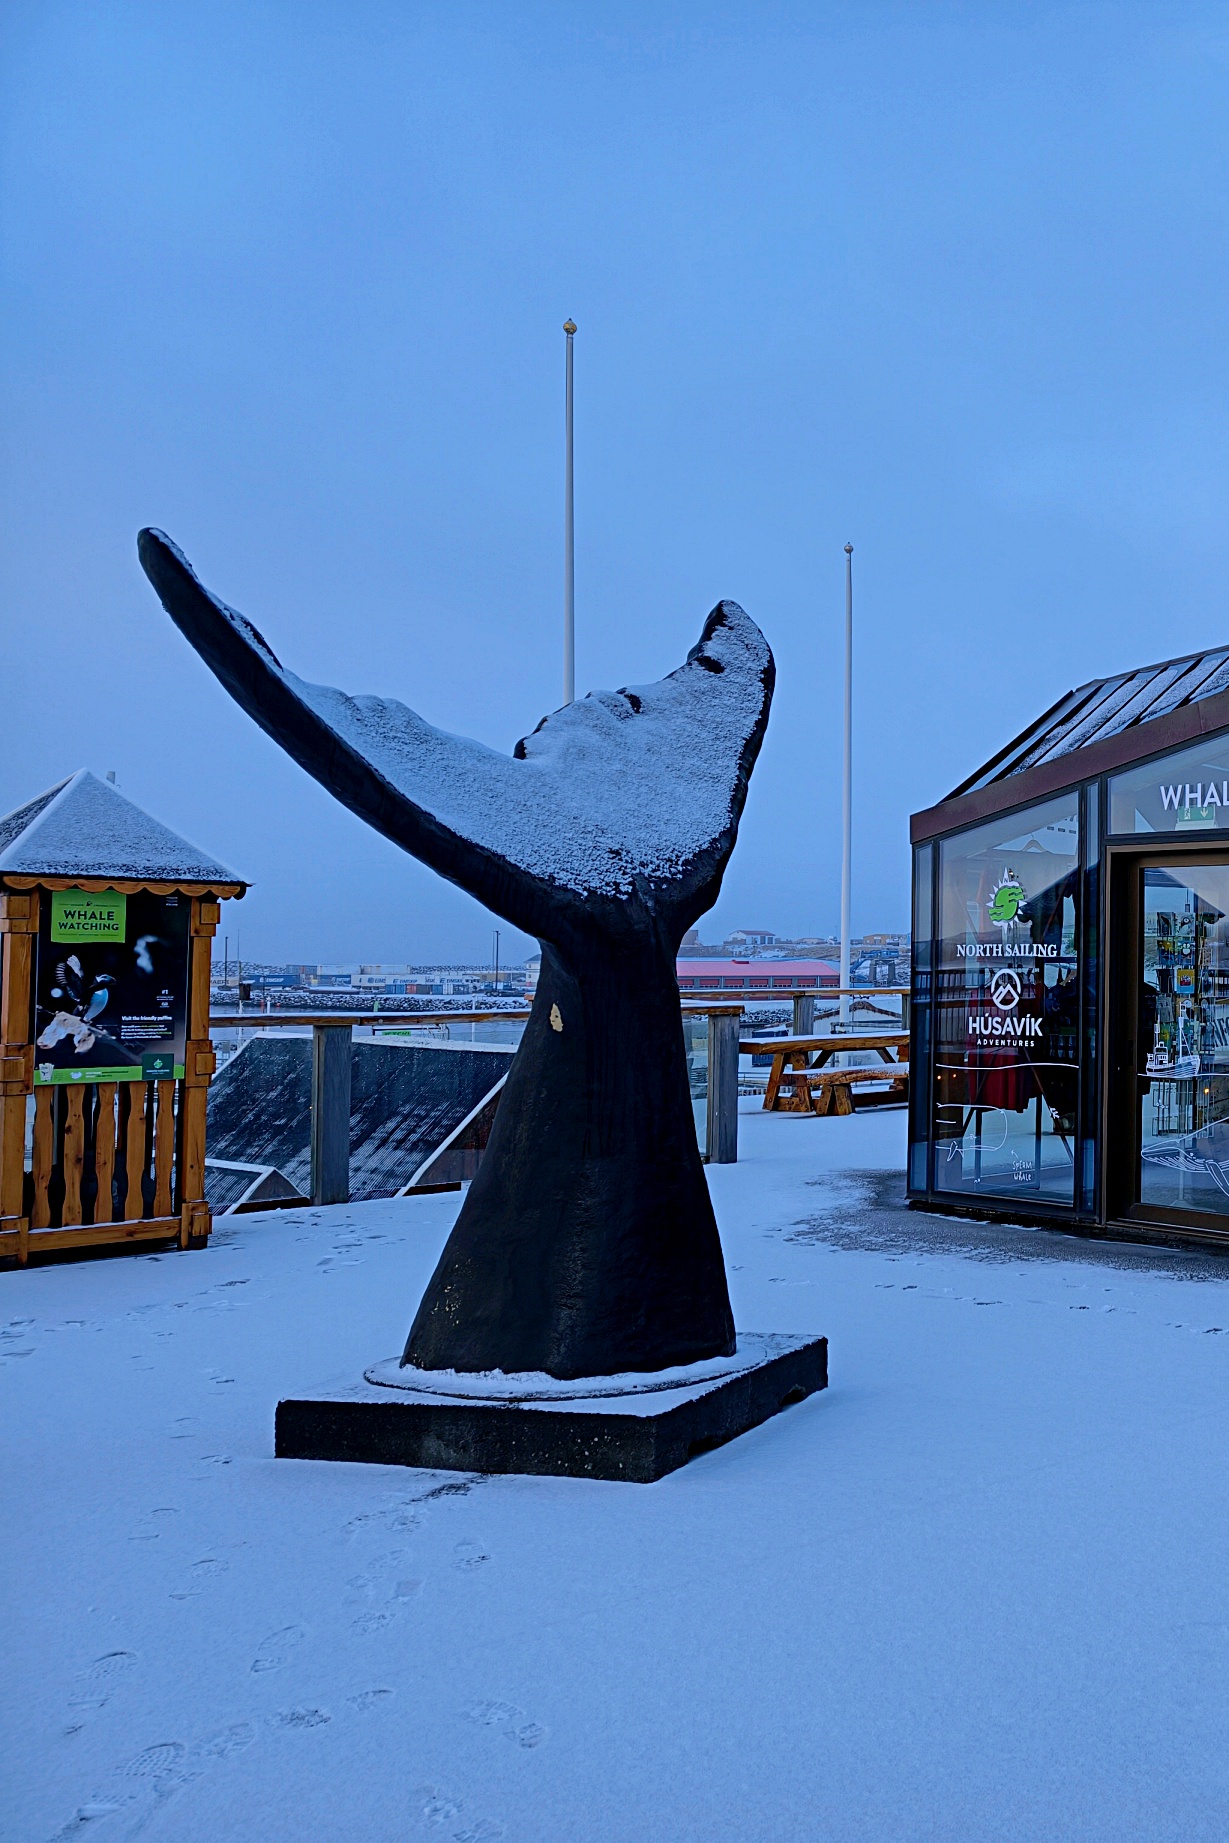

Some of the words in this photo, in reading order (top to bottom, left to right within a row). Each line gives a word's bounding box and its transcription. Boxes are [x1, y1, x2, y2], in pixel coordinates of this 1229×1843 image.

[63, 909, 115, 921] WHALE
[58, 921, 119, 931] WATCHING
[956, 943, 1003, 957] NORTH
[1003, 943, 1057, 957] SAILING
[968, 1013, 1043, 1037] HÚSAVÍK
[977, 1038, 1035, 1047] ADVENTURES
